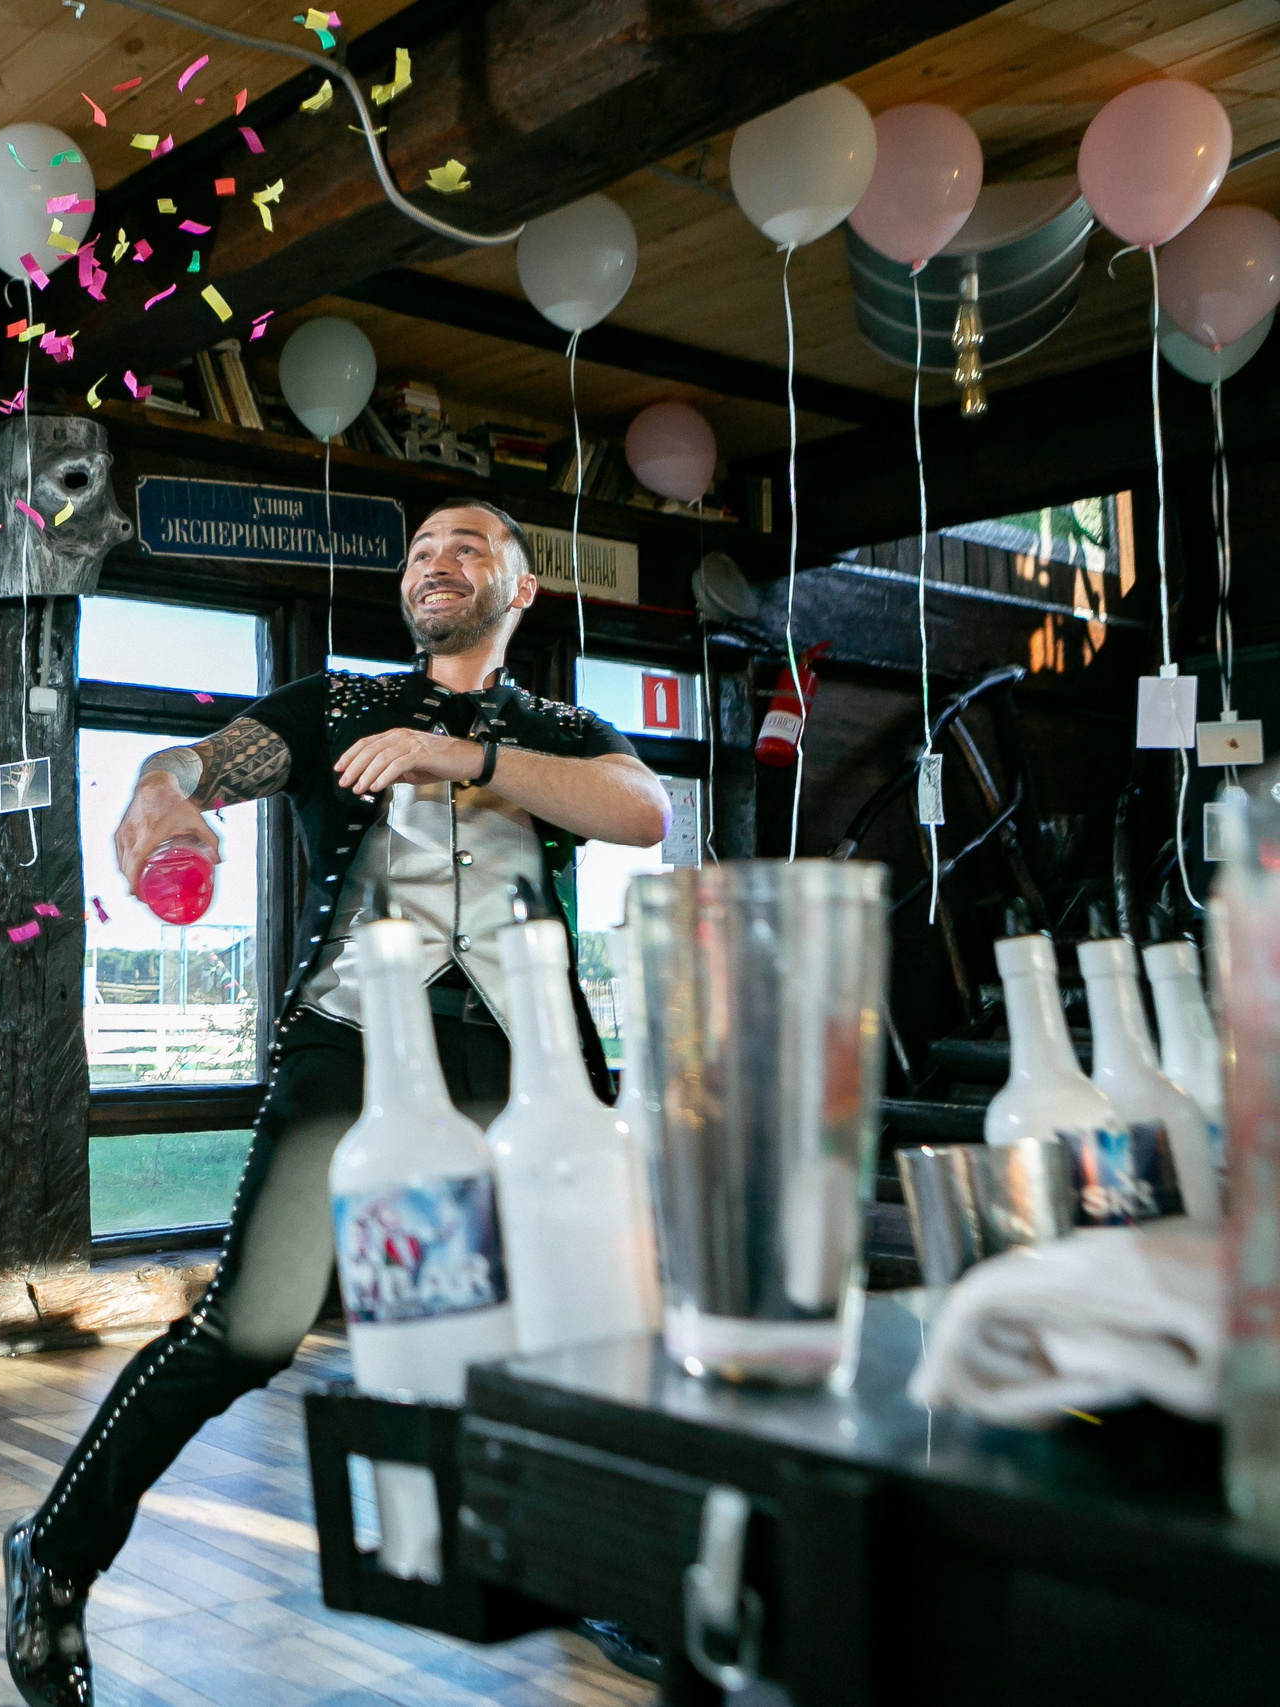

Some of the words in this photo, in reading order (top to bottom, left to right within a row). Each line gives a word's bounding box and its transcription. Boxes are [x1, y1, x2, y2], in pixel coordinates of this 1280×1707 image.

[252, 496, 304, 521] улица
[160, 517, 387, 558] ЭКСПЕРИМЕНТАЛЬНАЯ
[528, 531, 617, 588] ВИАЦОННАЯ
